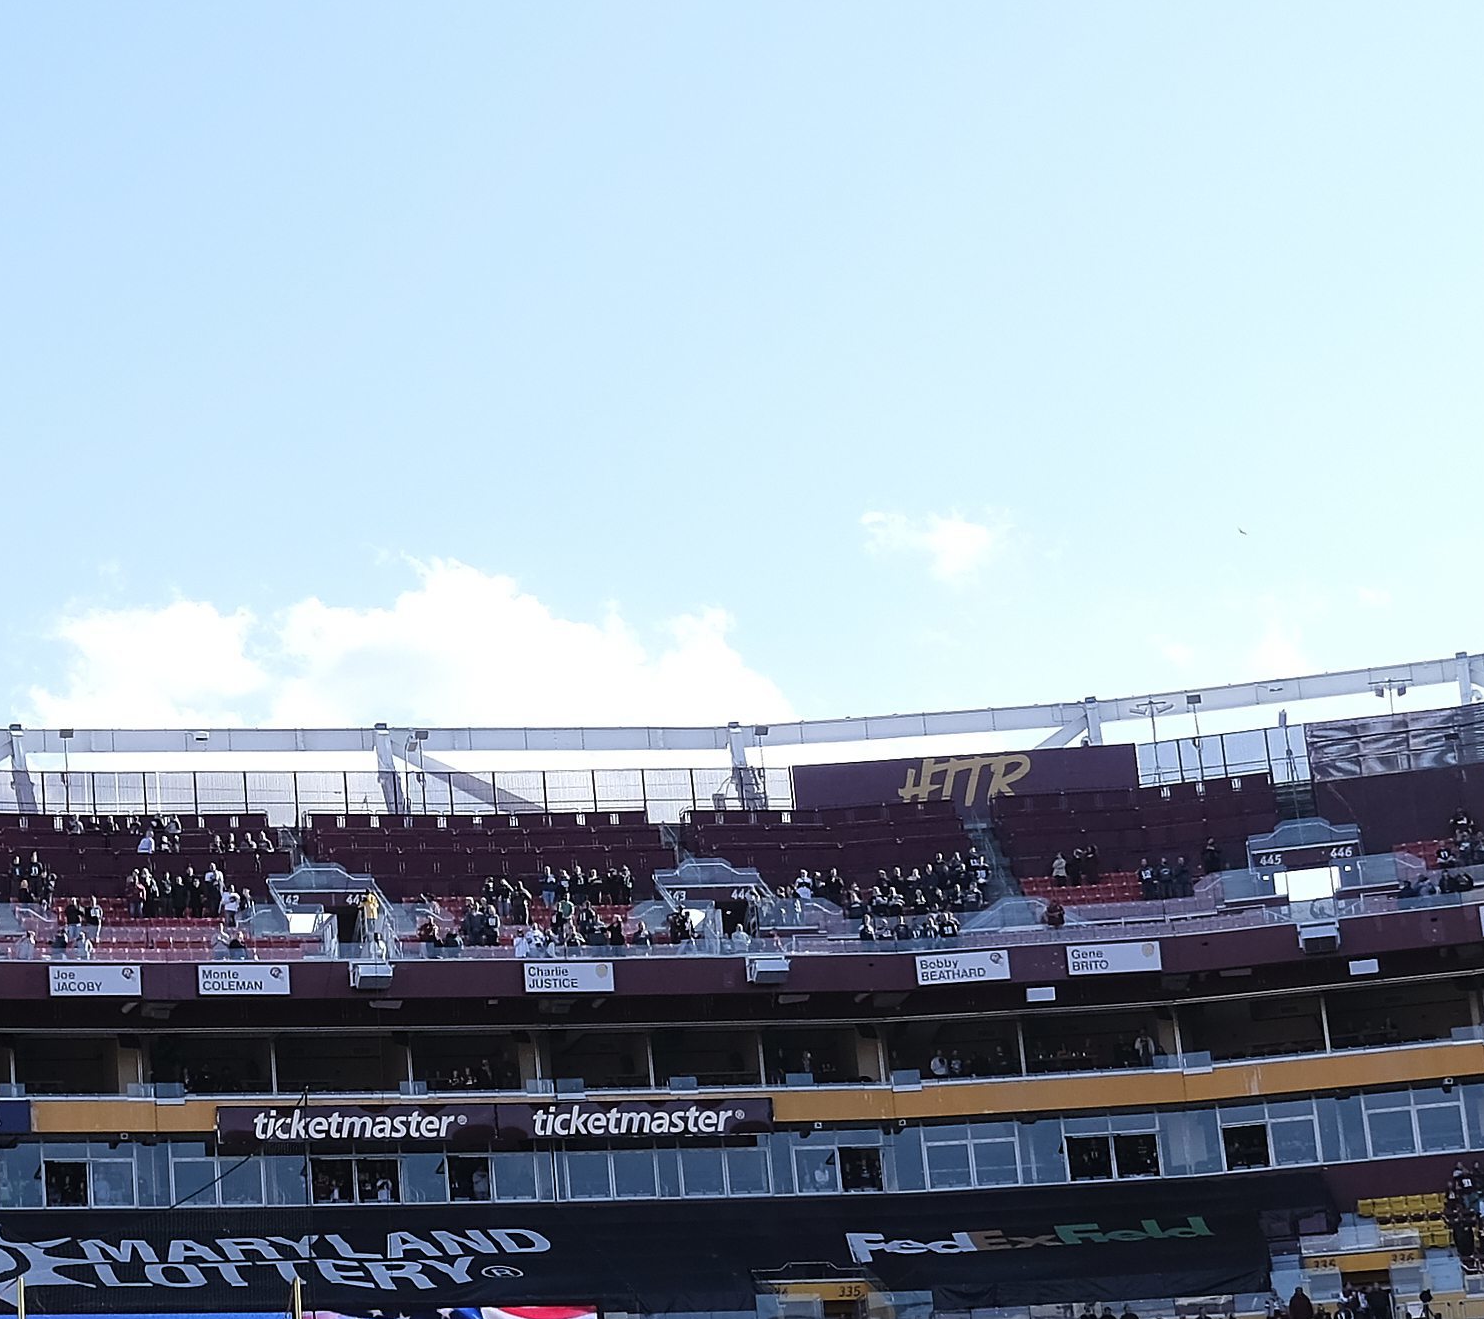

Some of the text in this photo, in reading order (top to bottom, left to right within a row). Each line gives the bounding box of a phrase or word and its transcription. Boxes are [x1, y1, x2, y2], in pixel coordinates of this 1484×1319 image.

[1259, 855, 1282, 867] 445
[1071, 949, 1103, 962] Gene
[919, 958, 959, 973] Bobby
[1072, 958, 1109, 971] BRITO
[54, 970, 76, 981] Joe
[201, 969, 239, 980] Monte
[528, 966, 569, 977] Charlie
[921, 966, 986, 981] BEATHARD
[54, 982, 102, 993] JACOBY
[202, 981, 263, 992] COLEMAN
[528, 978, 578, 989] JUSTICE
[254, 1110, 454, 1139] ticketmaster
[533, 1106, 732, 1136] ticketmaster
[80, 1228, 552, 1264] MARYLAND
[844, 1216, 1213, 1263] FedExField
[98, 1256, 476, 1290] LOTTERY
[838, 1285, 862, 1298] 335
